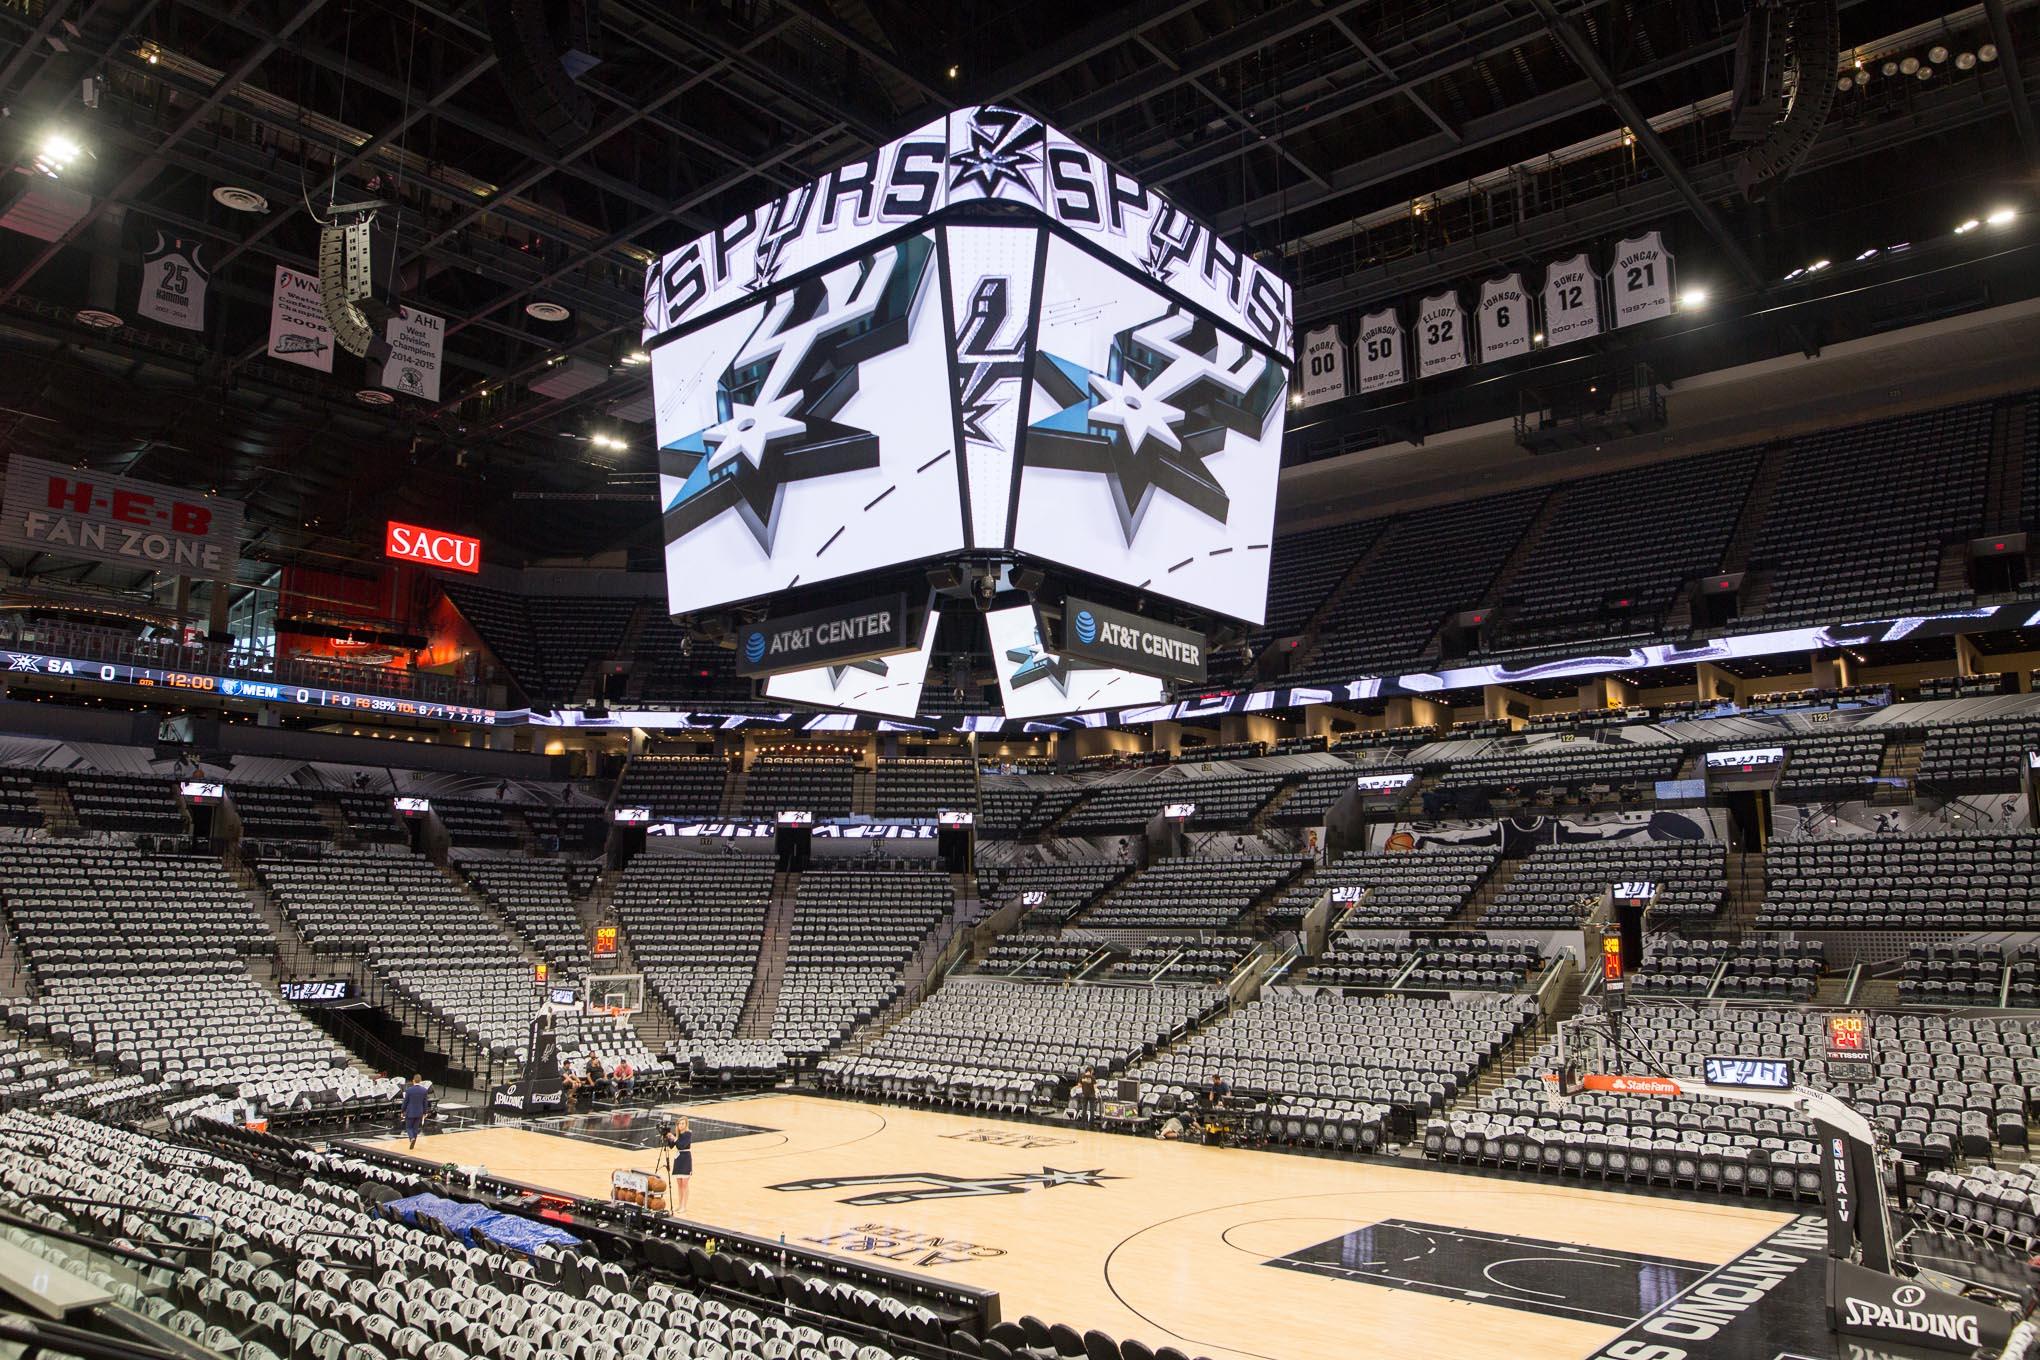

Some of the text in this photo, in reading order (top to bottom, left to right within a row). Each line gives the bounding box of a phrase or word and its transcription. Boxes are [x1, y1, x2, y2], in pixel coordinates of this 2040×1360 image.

[663, 142, 946, 324] SPURS
[1048, 148, 1284, 349] SPURS
[1620, 250, 1658, 269] DUNCAN
[161, 261, 189, 294] 25
[294, 277, 320, 294] WN
[1553, 272, 1584, 289] BOWEN
[1627, 263, 1654, 292] 21
[1483, 291, 1521, 310] JOHNSON
[1558, 286, 1583, 311] 12
[281, 314, 327, 332] 2008
[414, 315, 439, 330] AHL
[1423, 308, 1455, 324] ELLIOTT
[1496, 306, 1510, 328] 6
[407, 326, 426, 338] West
[1361, 325, 1397, 343] ROBINSON
[1427, 320, 1453, 345] 32
[1552, 318, 1594, 335] 2001-09
[392, 340, 436, 358] Champions
[400, 333, 430, 348] Division
[1309, 341, 1335, 354] MOORE
[1368, 337, 1392, 361] 50
[1487, 337, 1524, 351] 1991-01
[391, 352, 435, 370] 2014-2015
[1311, 352, 1335, 376] 00
[1307, 383, 1342, 396] 1980-90
[23, 511, 222, 571] FAN ZONE
[391, 527, 478, 567] SACU
[769, 611, 891, 655] AT&T CENTER
[1100, 621, 1200, 666] AT&T CENTER
[47, 659, 74, 675] SA
[100, 665, 115, 681] 0
[144, 670, 150, 678] 1
[166, 673, 214, 691] 12:00
[242, 684, 278, 699] MEM
[296, 689, 309, 703] 0
[332, 694, 339, 704] F
[356, 698, 370, 708] FG
[371, 700, 396, 712] 39%
[397, 703, 417, 714] TOL
[472, 715, 482, 723] 17
[484, 716, 496, 724] 35
[1812, 714, 1829, 722] 123
[1561, 734, 1575, 742] 122
[597, 928, 616, 938] 12:00
[597, 938, 613, 952] 24
[1607, 953, 1620, 978] 24
[1833, 1019, 1862, 1031] 12:00
[1837, 1032, 1857, 1047] 24
[495, 1092, 524, 1109] SPALDING
[1833, 1159, 1849, 1222] NBA TV
[1767, 1215, 1828, 1250] SAN
[1643, 1248, 1808, 1340] ANTONIO
[1845, 1297, 1982, 1347] SPALDING
